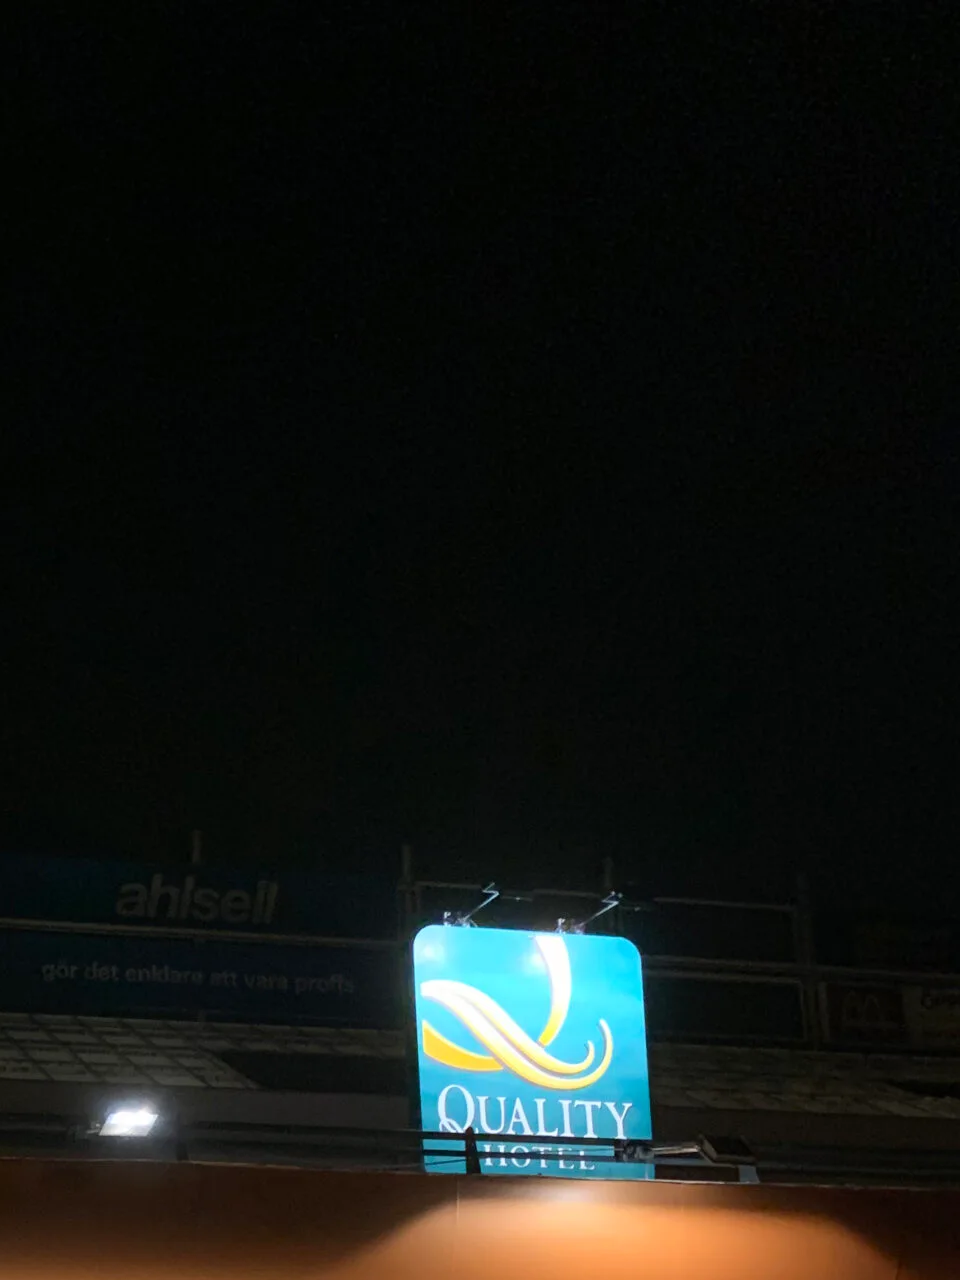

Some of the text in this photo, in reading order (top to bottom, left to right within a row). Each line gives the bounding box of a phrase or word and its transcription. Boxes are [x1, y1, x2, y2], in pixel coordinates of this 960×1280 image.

[115, 872, 280, 925] ahlsell
[41, 958, 78, 983] gör
[84, 961, 119, 981] det
[437, 1084, 632, 1140] QUALITY
